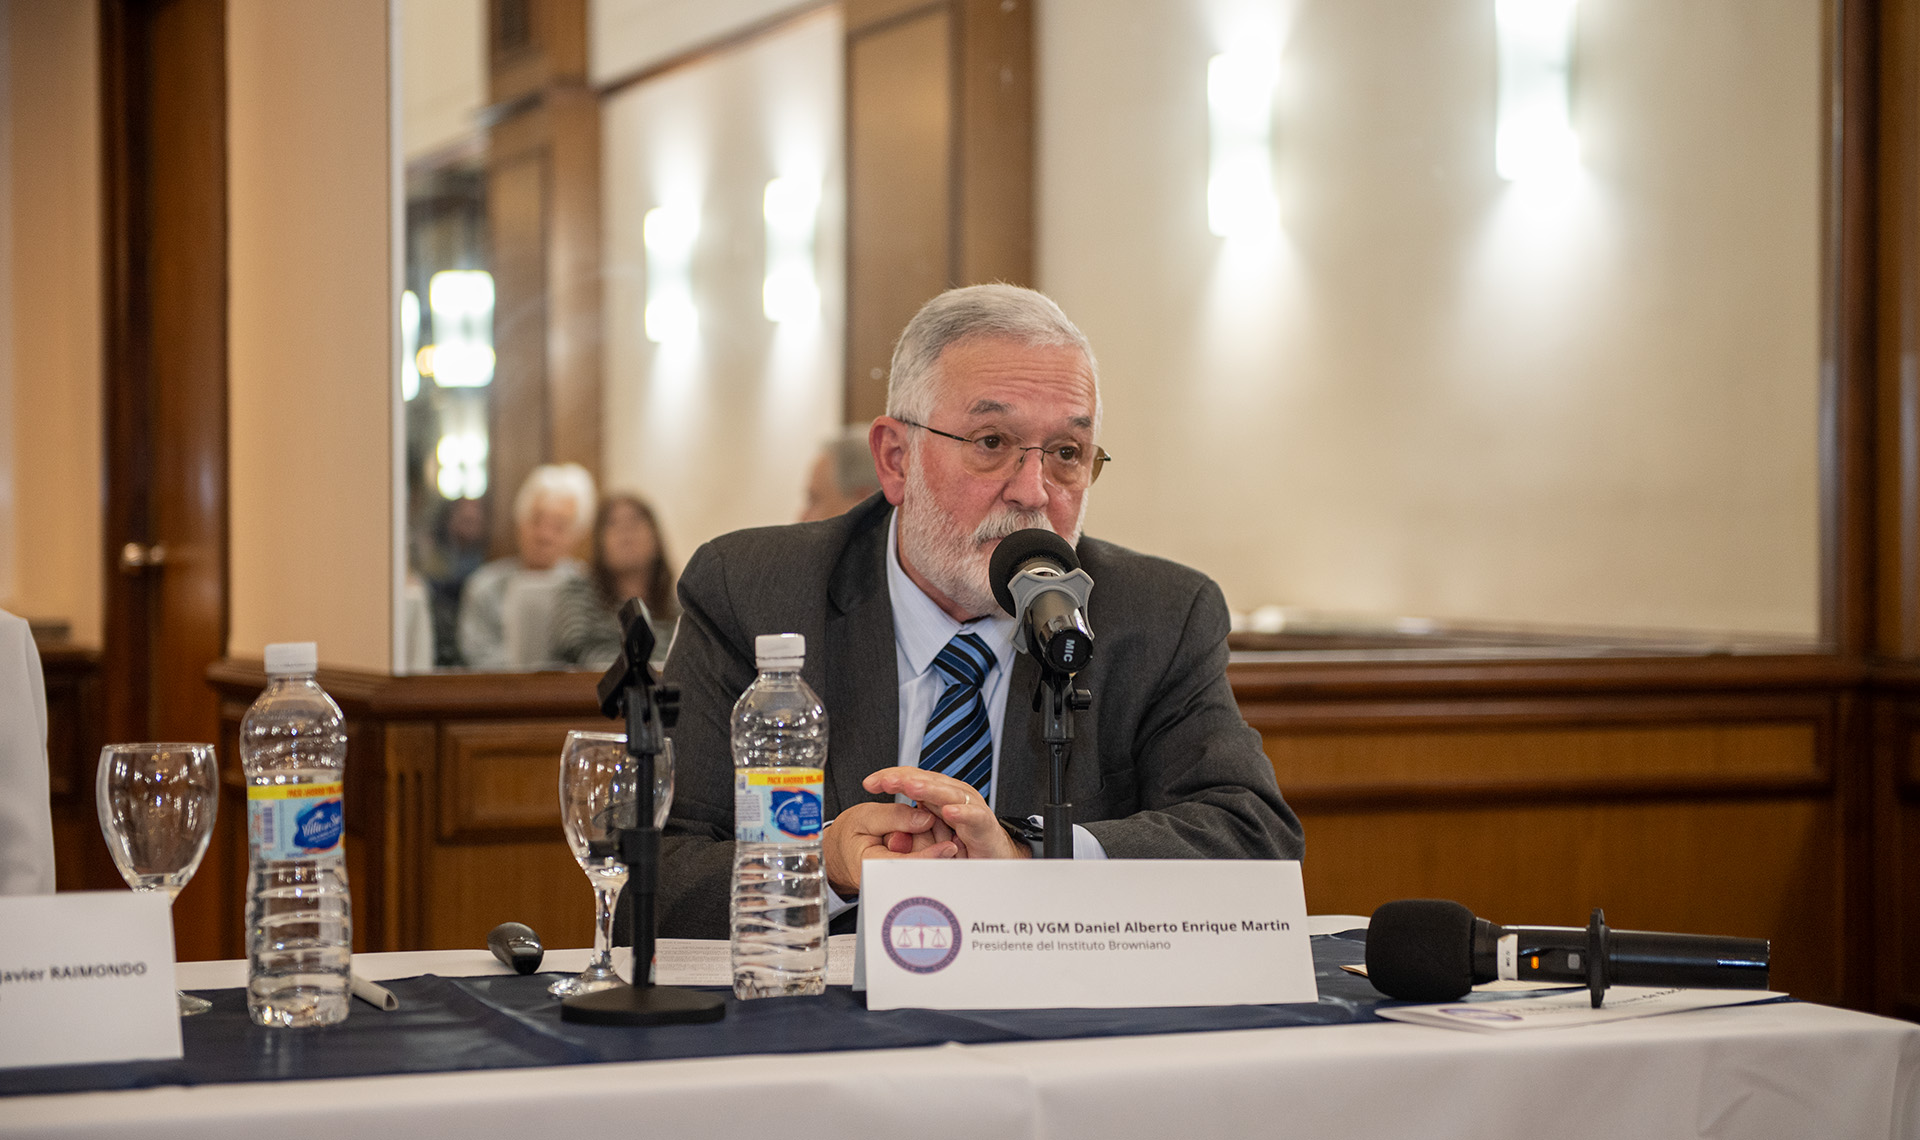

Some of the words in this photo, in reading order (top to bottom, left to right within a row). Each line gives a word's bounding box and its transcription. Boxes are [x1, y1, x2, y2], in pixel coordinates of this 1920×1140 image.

[1063, 639, 1075, 663] MIC
[971, 922, 1010, 934] Almt.
[1014, 922, 1033, 935] (R)
[1037, 922, 1070, 933] VGM
[1074, 922, 1120, 934] Daniel
[1124, 922, 1178, 933] Alberto
[1182, 921, 1238, 935] Enrique
[1242, 919, 1290, 931] Martin
[972, 940, 1033, 951] Presidente
[1036, 940, 1054, 951] del
[1058, 940, 1105, 951] Instituto
[1109, 940, 1171, 950] Browniano
[50, 962, 147, 981] RAIMONDO
